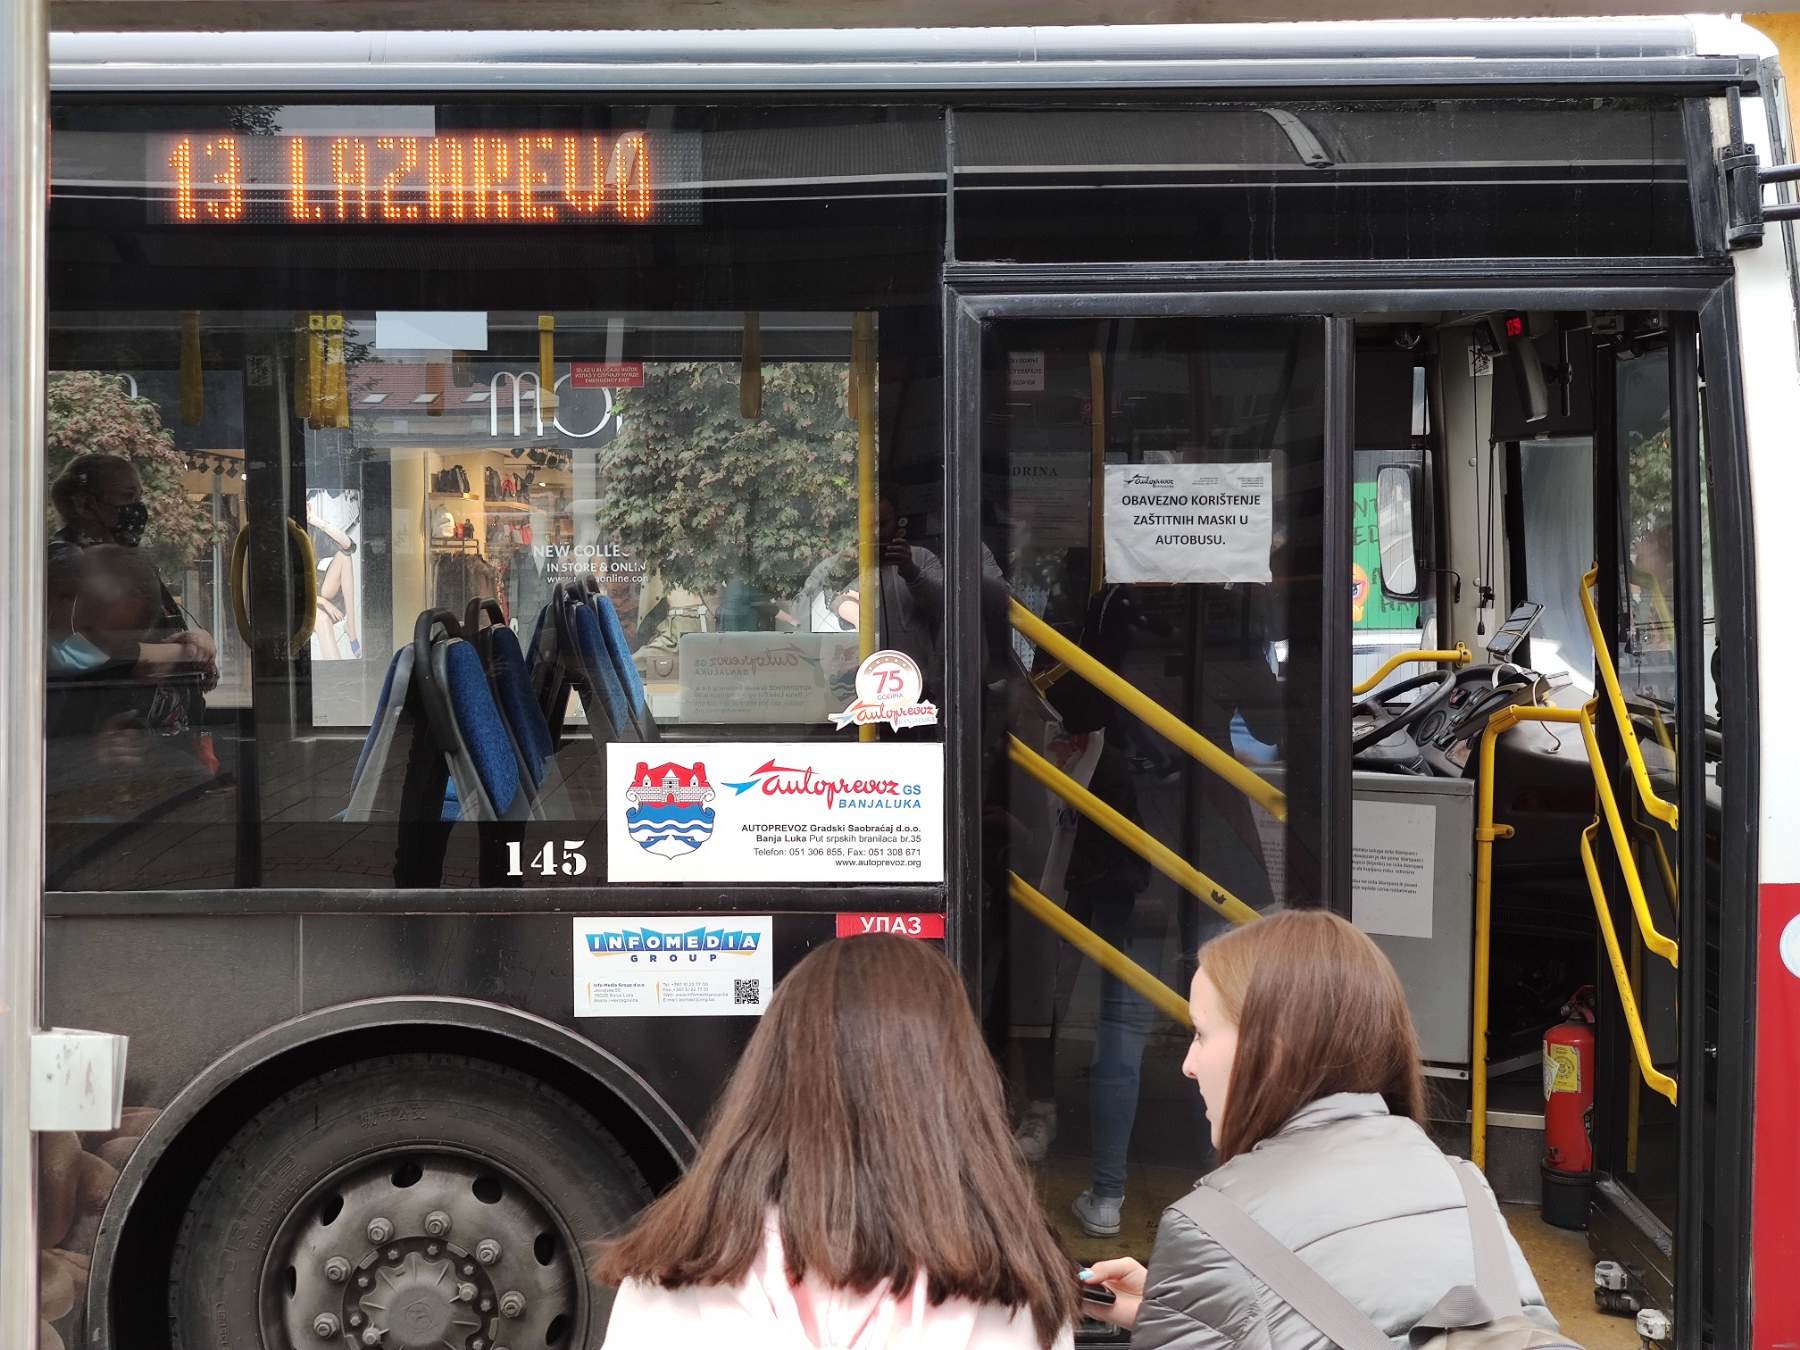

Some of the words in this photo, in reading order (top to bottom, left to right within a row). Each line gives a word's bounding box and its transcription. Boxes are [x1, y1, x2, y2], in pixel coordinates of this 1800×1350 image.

[167, 136, 242, 219] 13
[1012, 466, 1058, 477] DRINA
[1121, 495, 1188, 506] OBAVEZNO
[1191, 493, 1261, 506] KORIŠTENJE
[1133, 513, 1194, 525] ZAŠTITNIH
[1198, 515, 1236, 525] MASKI
[1240, 515, 1249, 525] U
[1155, 535, 1226, 545] AUTOBUSU.
[533, 544, 570, 557] NEW
[547, 562, 559, 572] IN
[561, 562, 597, 572] STORE
[599, 562, 608, 572] &
[873, 670, 904, 694] 75
[761, 766, 900, 810] autoprevoz
[903, 784, 922, 795] GS
[838, 799, 922, 809] BANJALUKA
[741, 824, 807, 832] AUTOPREVOZ
[810, 824, 845, 832] Gradski
[848, 824, 894, 834] Saobraćaj
[896, 824, 921, 832] d.o.o.
[756, 835, 782, 844] Banja
[809, 834, 824, 842] Put
[826, 835, 857, 844] srpskih
[859, 834, 898, 843] branilaca
[900, 834, 922, 842] br.35
[753, 847, 786, 856] Telefon:
[789, 848, 805, 856] 051
[808, 848, 824, 856] 306
[826, 848, 845, 857] 855,
[847, 848, 866, 856] Fax:
[868, 848, 884, 856] 051
[887, 848, 903, 856] 308
[905, 848, 921, 856] 671
[505, 840, 588, 876] 145
[835, 859, 922, 868] www.autoprevoz.org
[590, 932, 759, 950] INFOMEDIA
[630, 953, 717, 963] GROUP
